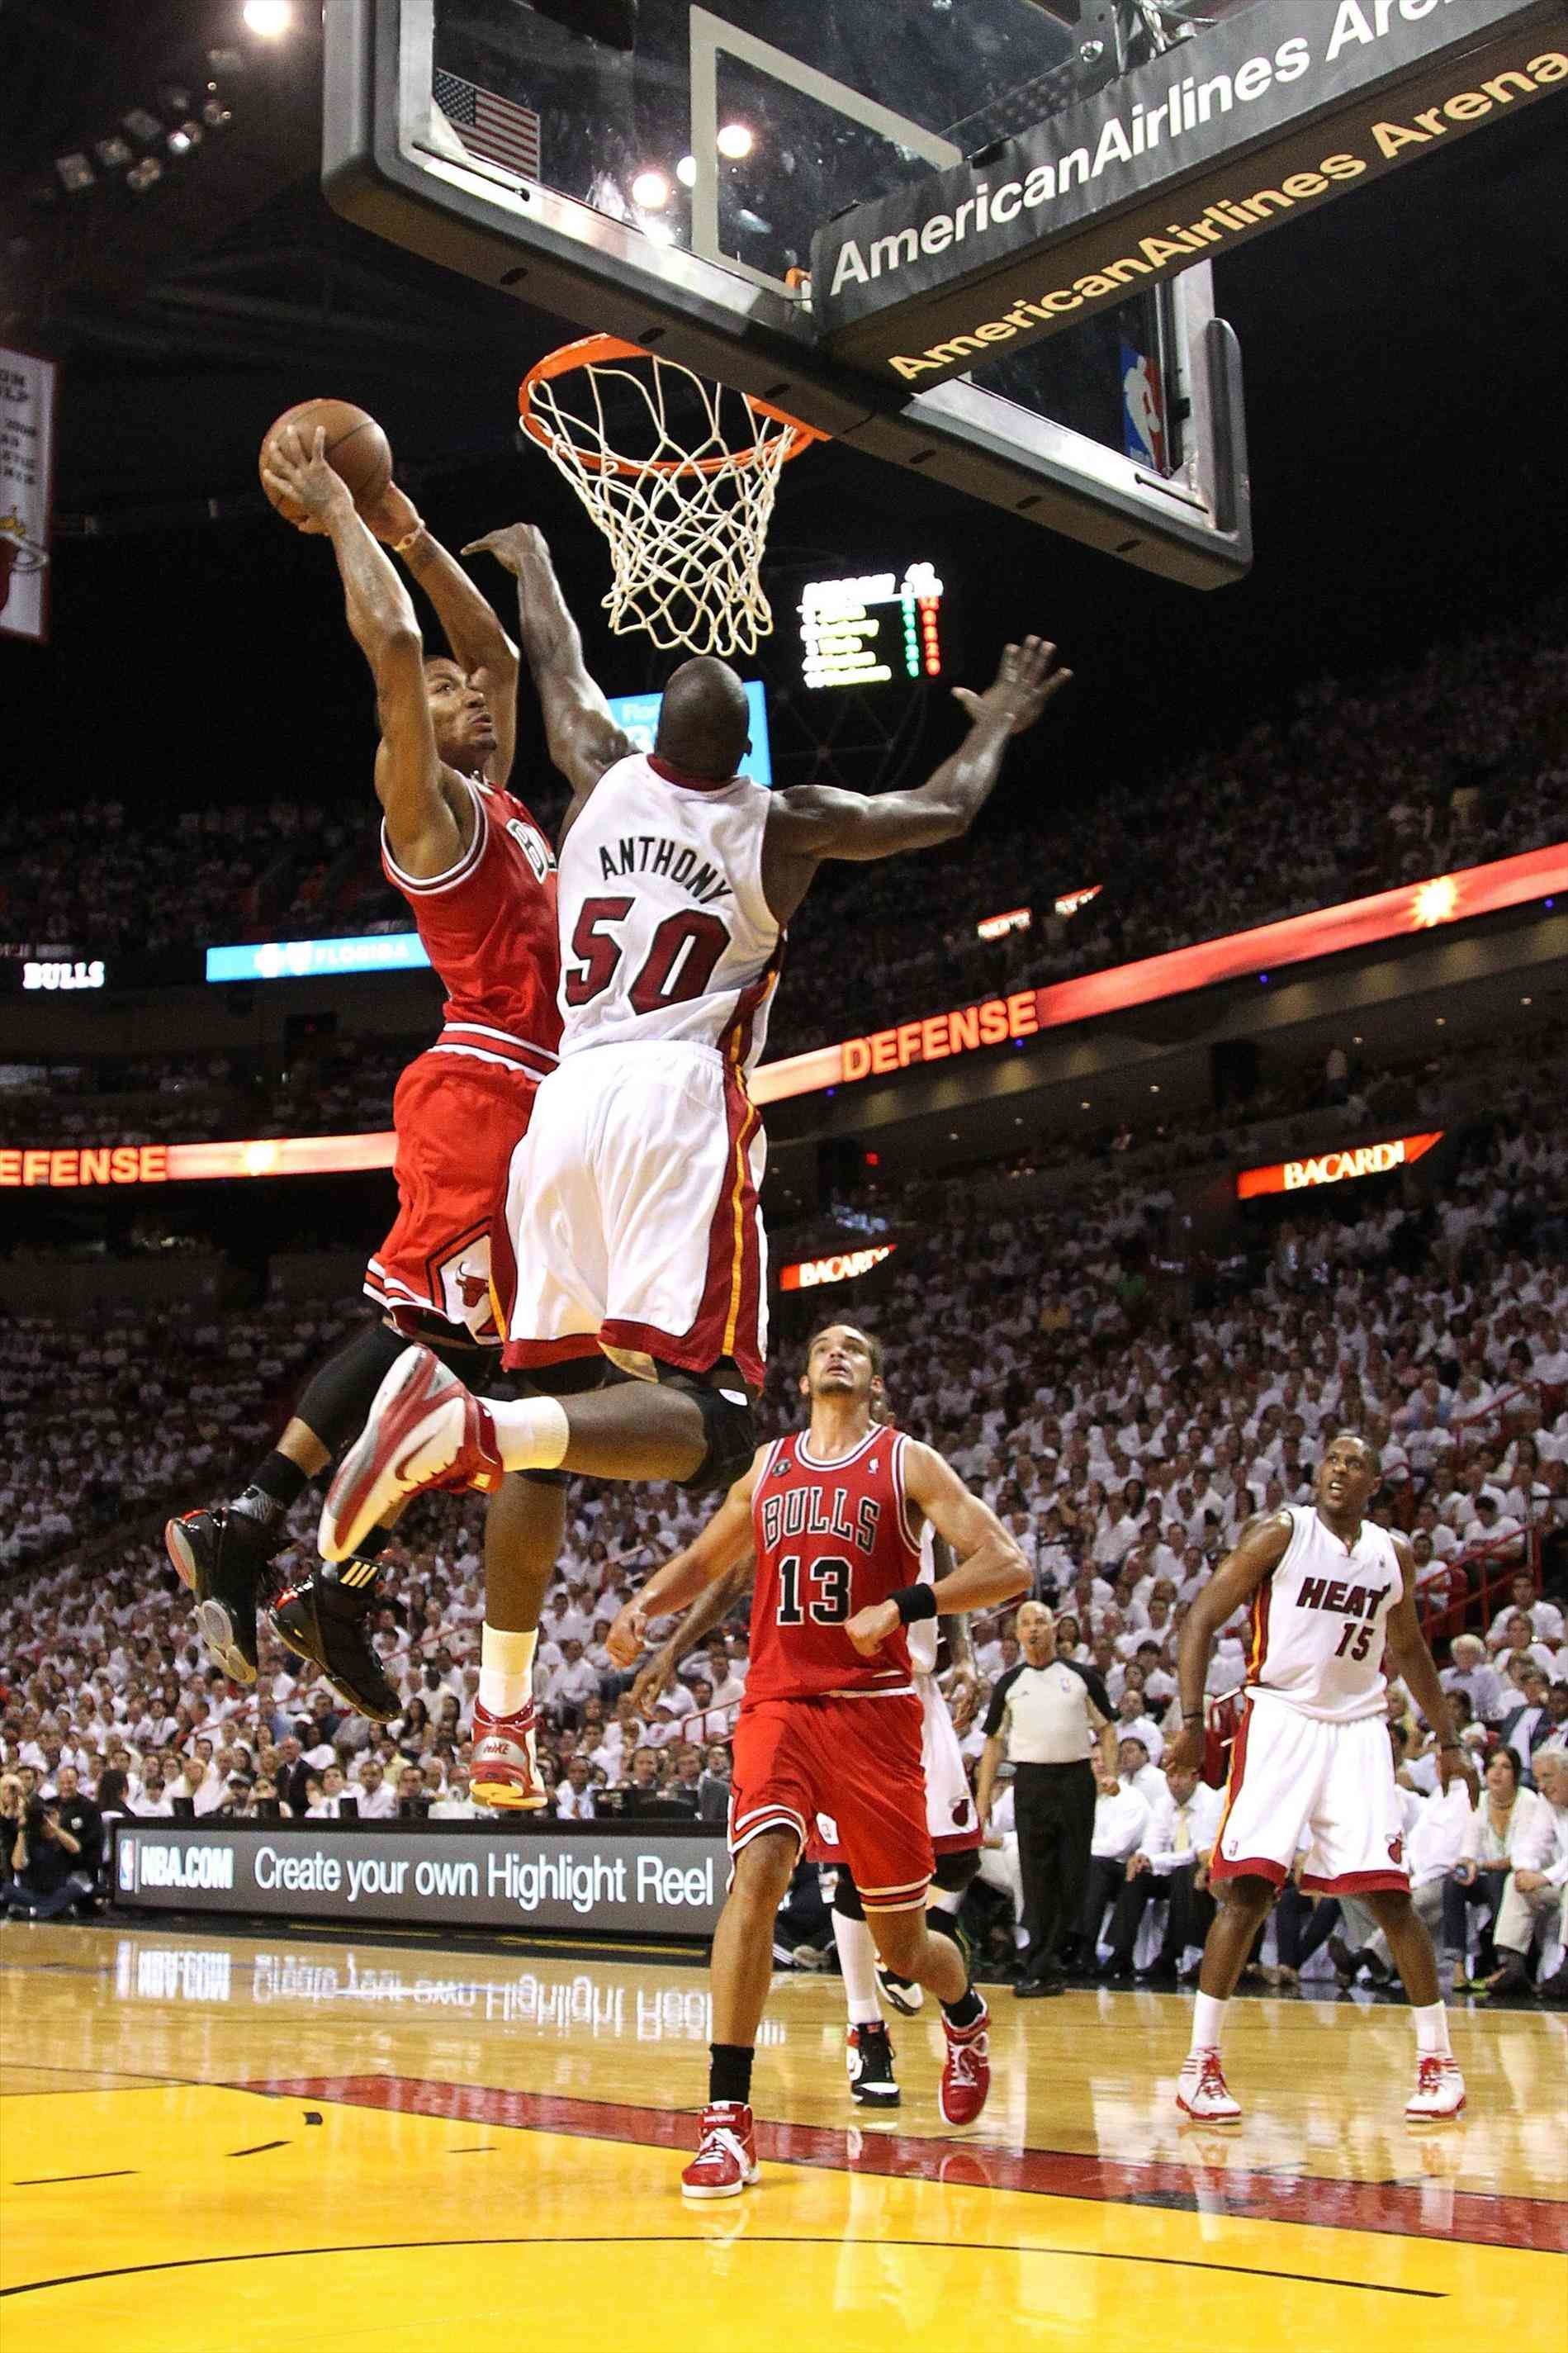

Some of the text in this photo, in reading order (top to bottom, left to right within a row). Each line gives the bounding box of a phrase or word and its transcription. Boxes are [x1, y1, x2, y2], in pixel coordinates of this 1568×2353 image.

[829, 0, 1463, 296] AmericanAirlines Are
[887, 51, 1568, 380] AmericanAirlines Arena
[599, 836, 732, 905] ANTHONY
[22, 961, 105, 989] BULLS
[565, 896, 732, 1016] 50
[841, 989, 1040, 1083] DEFENSE
[1284, 1140, 1405, 1191] BACARDI
[762, 1487, 881, 1555] BULLS
[776, 1555, 853, 1626] 13
[1296, 1576, 1391, 1620] HEAT
[1334, 1622, 1376, 1662] 15
[140, 1845, 713, 1914] NBA.COM Create your own Highlight Reel
